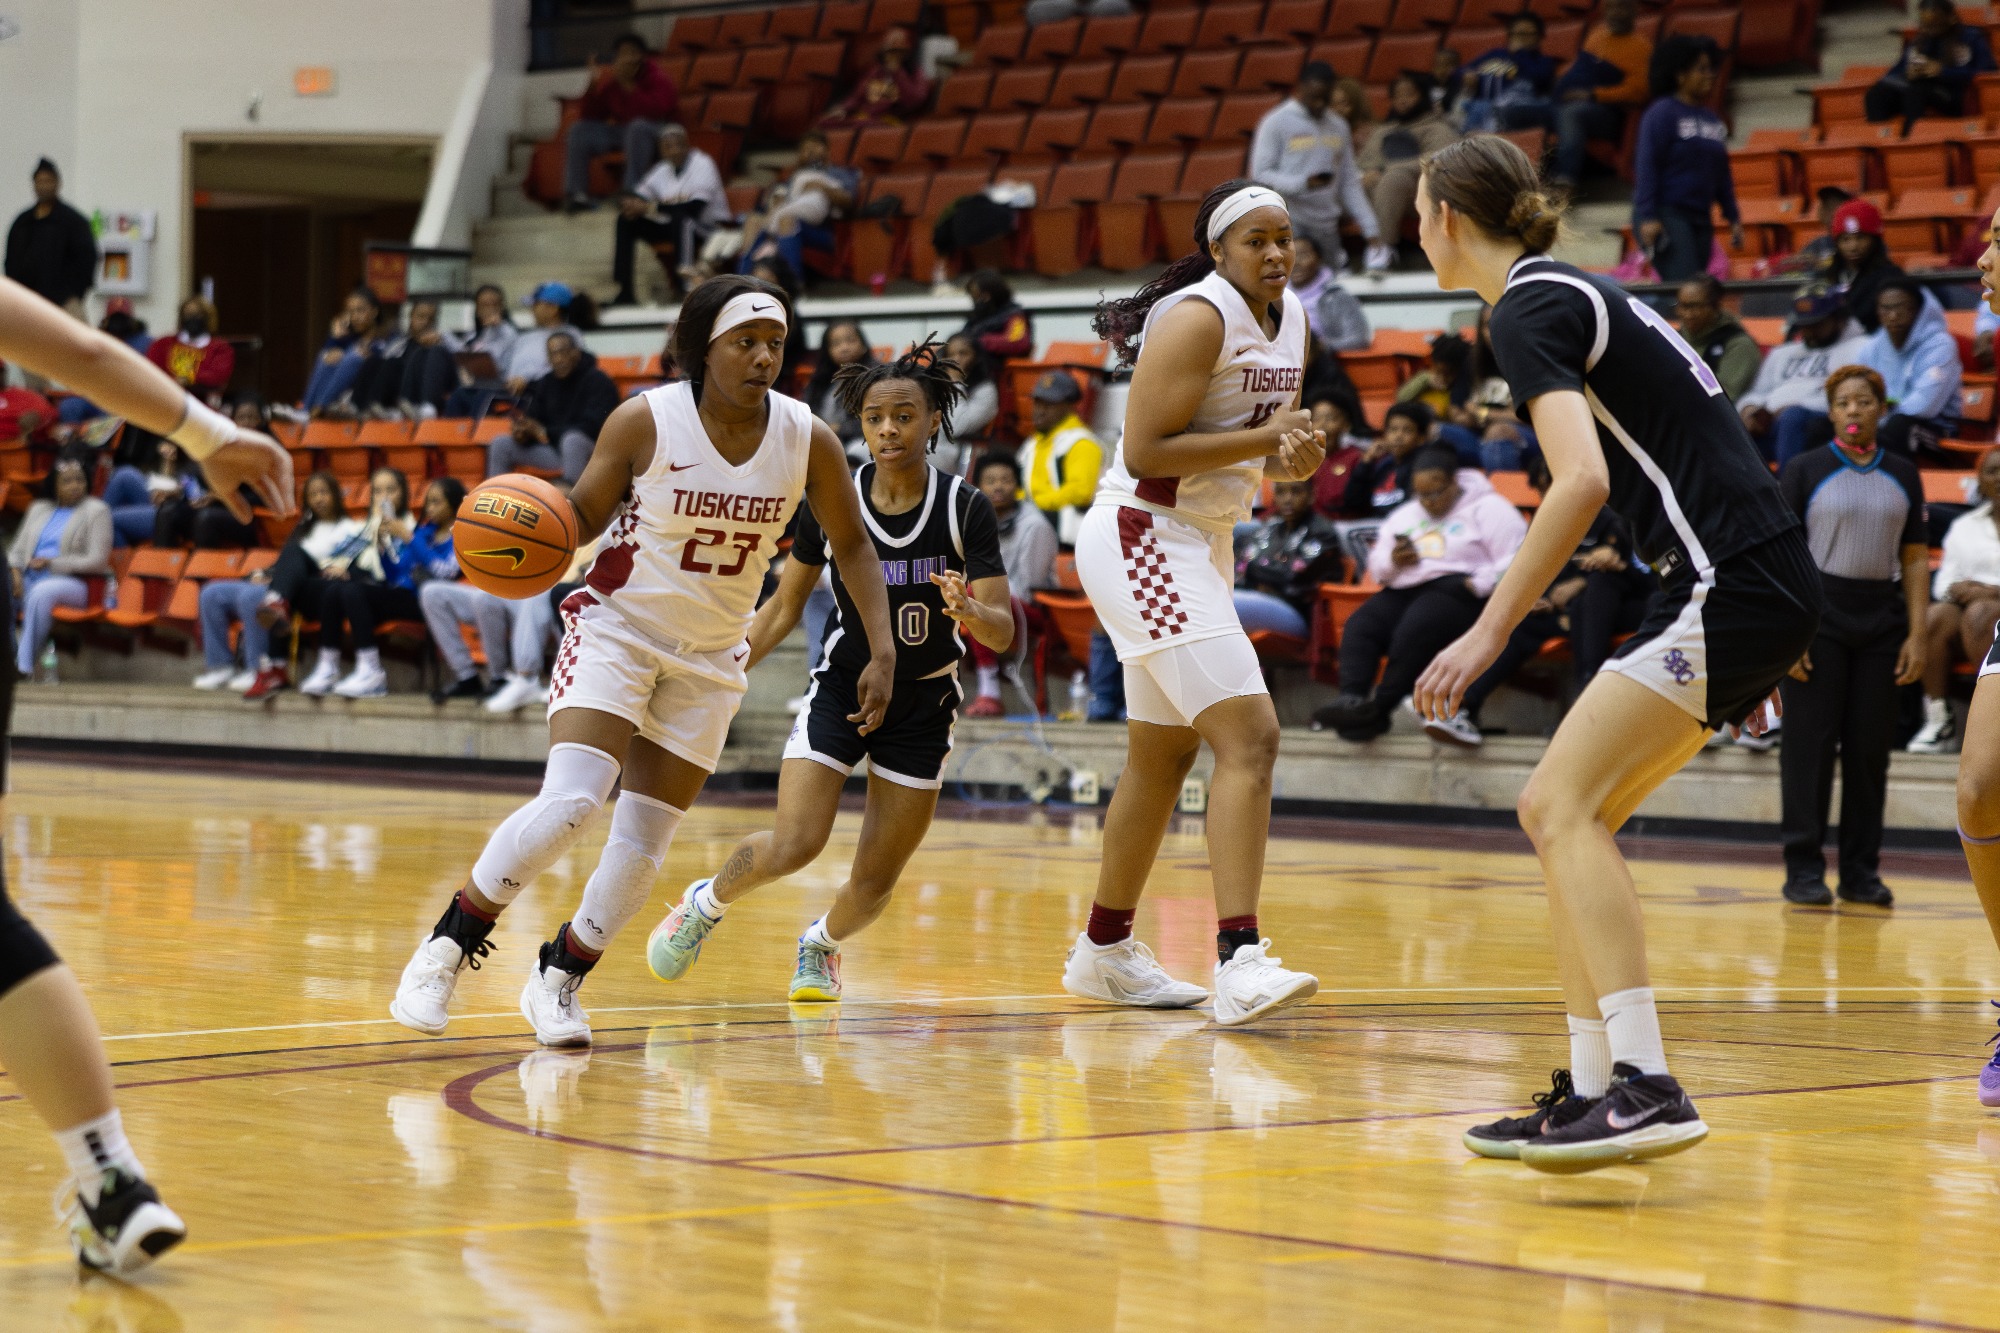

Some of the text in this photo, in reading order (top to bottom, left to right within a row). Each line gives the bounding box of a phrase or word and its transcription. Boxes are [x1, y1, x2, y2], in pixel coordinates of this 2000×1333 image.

[1626, 296, 1724, 398] 1
[473, 496, 542, 531] ELITE
[672, 488, 787, 524] TUSKEGEE
[680, 526, 763, 577] 23
[898, 602, 930, 646] 0
